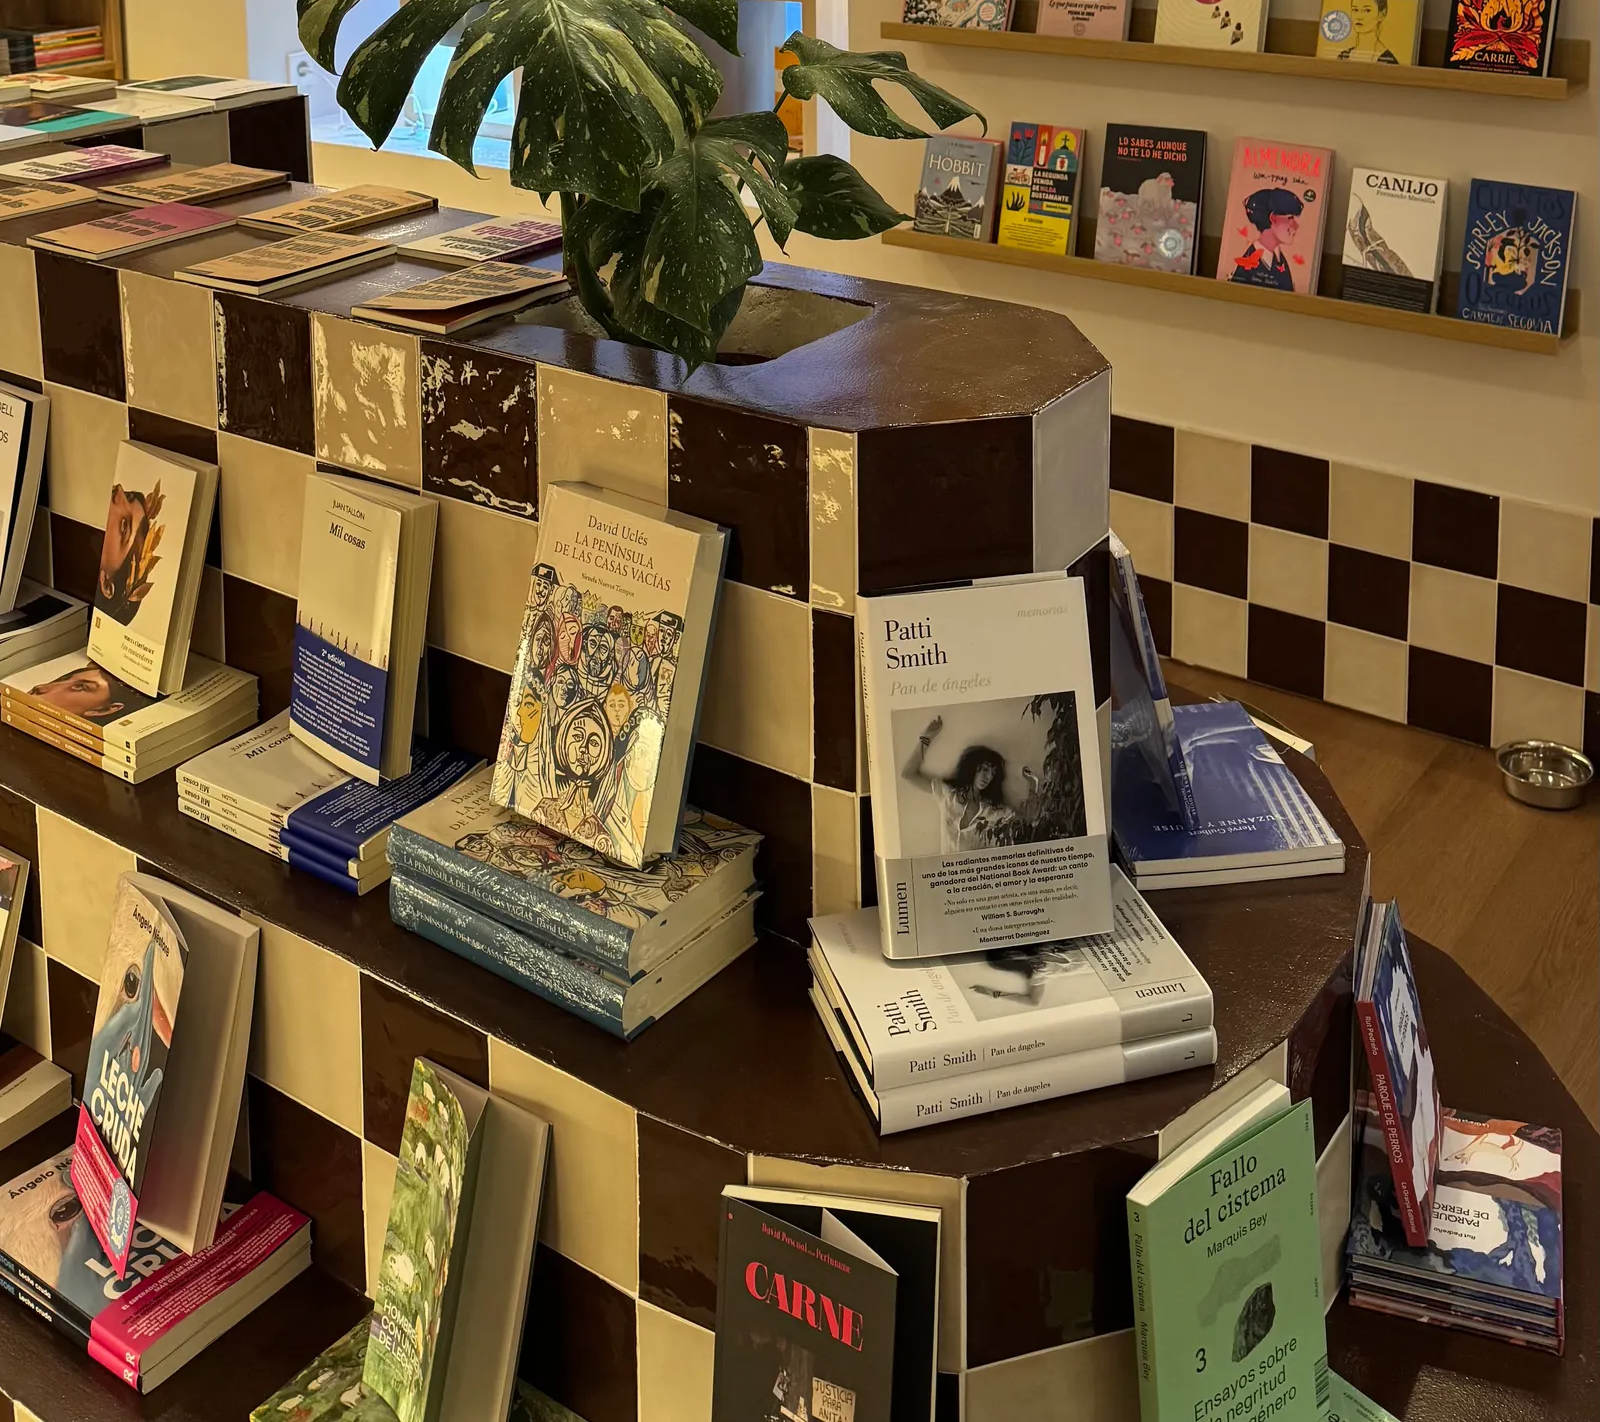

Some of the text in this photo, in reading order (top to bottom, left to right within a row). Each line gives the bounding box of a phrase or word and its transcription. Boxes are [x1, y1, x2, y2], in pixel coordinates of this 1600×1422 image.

[1474, 52, 1515, 64] CARRIE
[1117, 145, 1187, 162] NO TE LO HE DICHO
[1119, 136, 1187, 152] LO SABES AUNQUE
[928, 154, 986, 177] HOBBIT
[1041, 171, 1068, 180] SEGUNDA
[1244, 147, 1321, 177] ALMENDRA
[1031, 192, 1069, 202] BUSTAMANTE
[1366, 174, 1438, 197] CANIJO
[1376, 189, 1406, 199] Fernando
[1476, 185, 1565, 219] CUENTOS
[1466, 210, 1510, 269] SHIRLEY
[1528, 216, 1562, 286] JACKSON
[1462, 307, 1552, 334] CARMEN SEGOVIA
[332, 499, 346, 511] JUAN
[329, 522, 366, 549] Mil cosas
[588, 514, 648, 546] David Uclés
[575, 532, 654, 569] LA PENÍNSULA
[554, 541, 671, 592] DE LAS CASAS VACÍAS
[1017, 604, 1068, 618] memorias
[884, 617, 932, 642] Patti
[886, 643, 948, 669] Smith
[889, 673, 992, 696] Pan de ángeles
[245, 746, 267, 759] Mil
[451, 785, 484, 805] David
[449, 807, 489, 831] DE LAS
[455, 804, 473, 816] LA
[941, 860, 954, 868] Las
[955, 857, 990, 866] radiantes
[991, 852, 1026, 861] memorias
[1027, 846, 1064, 859] definitivas
[976, 852, 1095, 875] grandes iconos nuestro tiempo,
[414, 859, 504, 907] PENÍNSULA LAS CASAS
[930, 877, 966, 889] ganadora
[967, 876, 979, 884] del
[979, 871, 1011, 881] National
[1012, 869, 1030, 877] Book
[1032, 866, 1057, 874] Award:
[1069, 861, 1088, 870] canto
[962, 882, 993, 893] creación,
[1037, 873, 1074, 884] esperanza
[133, 904, 153, 934] Ángelo
[896, 881, 910, 935] Lumen
[981, 907, 1045, 921] William Burroughs
[979, 933, 1015, 944] Montserrat
[1134, 982, 1187, 998] Lumen
[877, 1002, 911, 1037] Patti
[900, 989, 937, 1033] Smith
[1365, 1015, 1378, 1056] Rut Pedreño
[909, 1038, 1045, 1073] Patti Smith Pan de ángeles
[100, 1049, 146, 1143] LECHE
[916, 1080, 1051, 1117] Patti Smith Pan de ángeles
[1375, 1074, 1403, 1164] PARQUE DE PERROS
[90, 1087, 138, 1191] CRUDA
[8, 1169, 55, 1200] Ángelo
[1209, 1152, 1258, 1198] Fallo
[1184, 1166, 1287, 1244] del cistema
[1473, 1210, 1490, 1220] DE
[761, 1222, 781, 1240] David
[1432, 1211, 1480, 1228] PARQUE
[1133, 1211, 1144, 1256] 3 Fallo
[1206, 1213, 1268, 1258] Marquis Bey
[167, 1233, 237, 1286] CELEBRADAS PREMIADAS
[129, 1268, 177, 1307] ESPERADO DEBUT
[18, 1292, 52, 1322] Leche cruda
[745, 1261, 864, 1352] CARNE
[381, 1315, 411, 1354] CON UN
[383, 1299, 418, 1349] HOMBRES
[378, 1330, 391, 1351] DE
[126, 1351, 135, 1365] R
[1195, 1347, 1207, 1373] 3
[124, 1368, 134, 1382] R
[1194, 1337, 1298, 1422] Ensayos sobre
[814, 1379, 853, 1406] JUSTICIA
[822, 1395, 842, 1413] PARA
[1226, 1364, 1286, 1422] negritud
